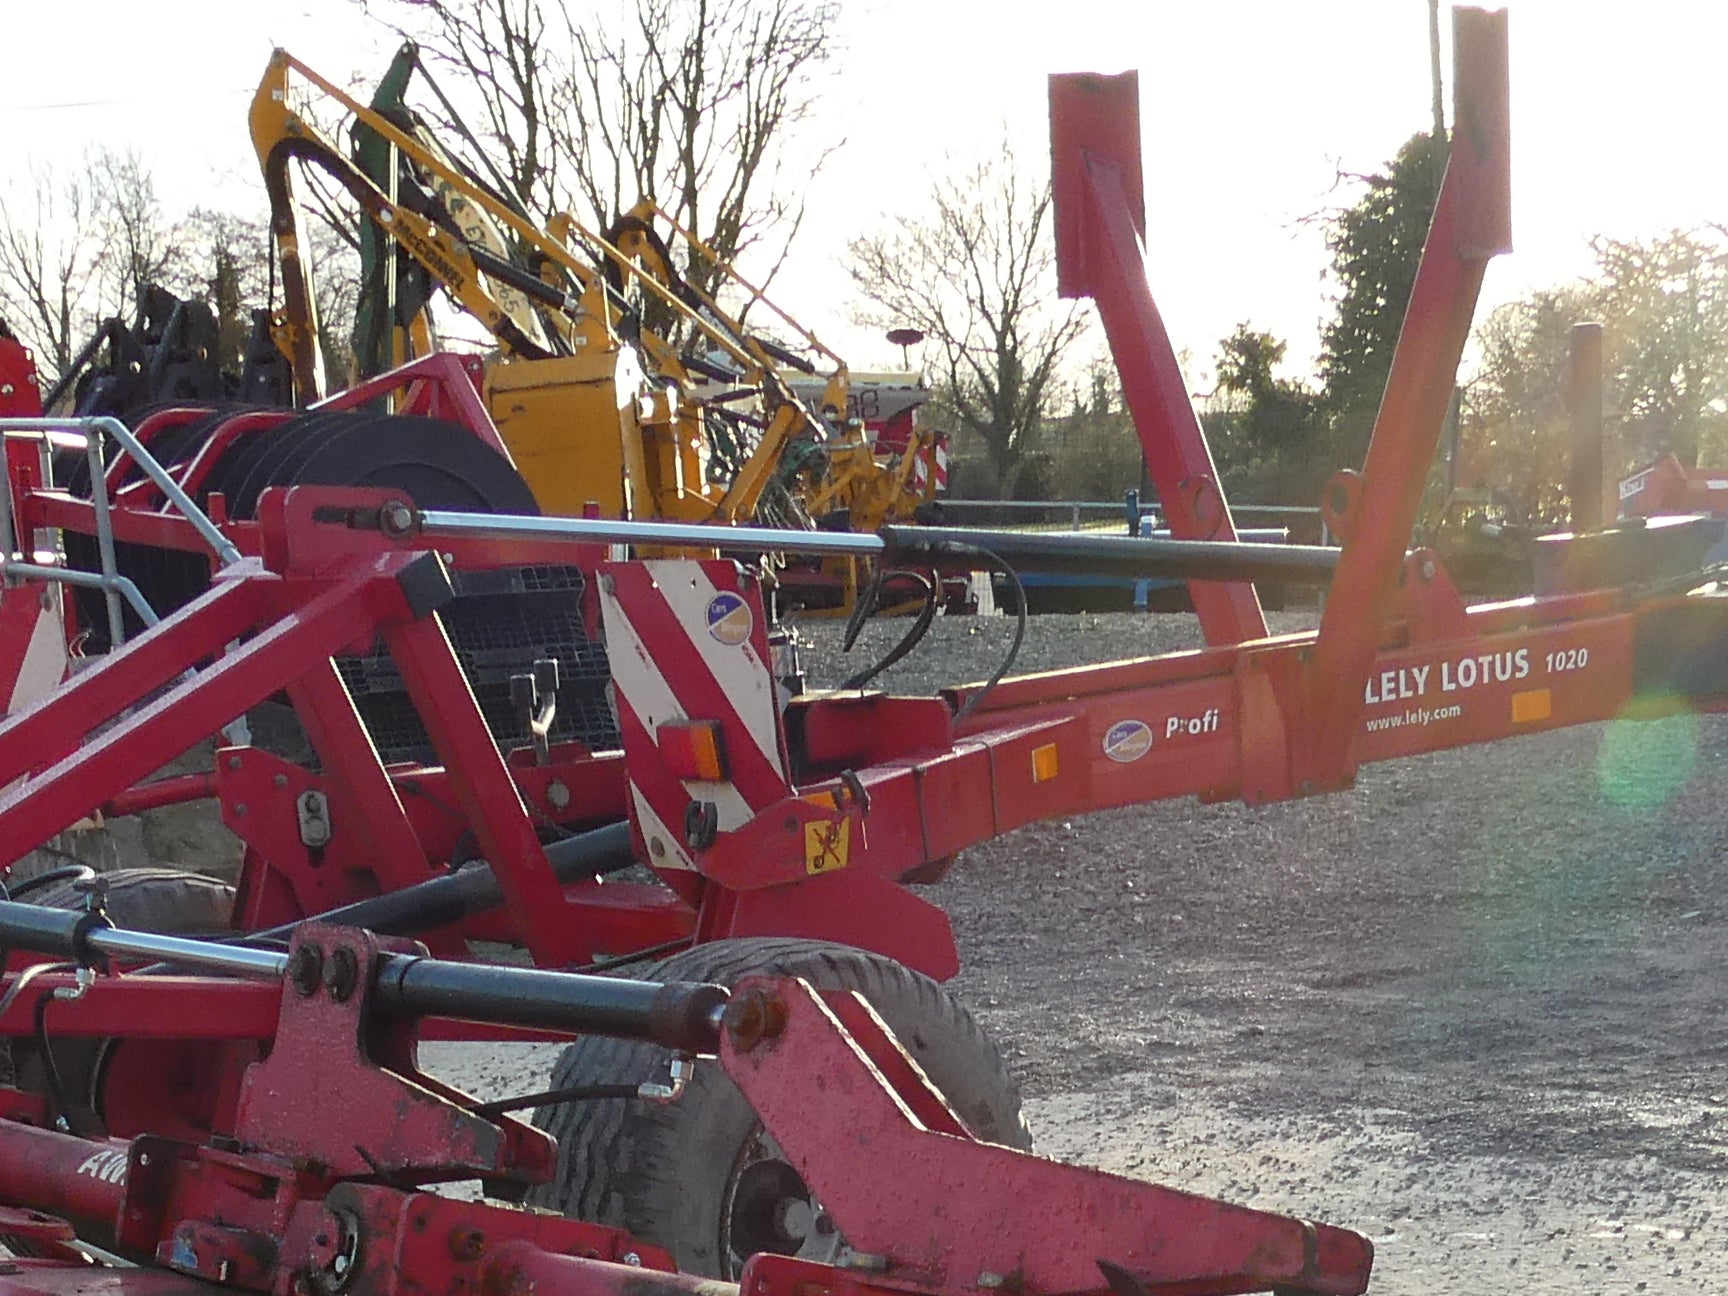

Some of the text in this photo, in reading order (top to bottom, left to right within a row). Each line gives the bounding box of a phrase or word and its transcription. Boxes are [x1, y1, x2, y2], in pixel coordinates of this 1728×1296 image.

[1365, 647, 1589, 704] LELY LOTUS 1020
[1366, 704, 1462, 732] www.lely.com
